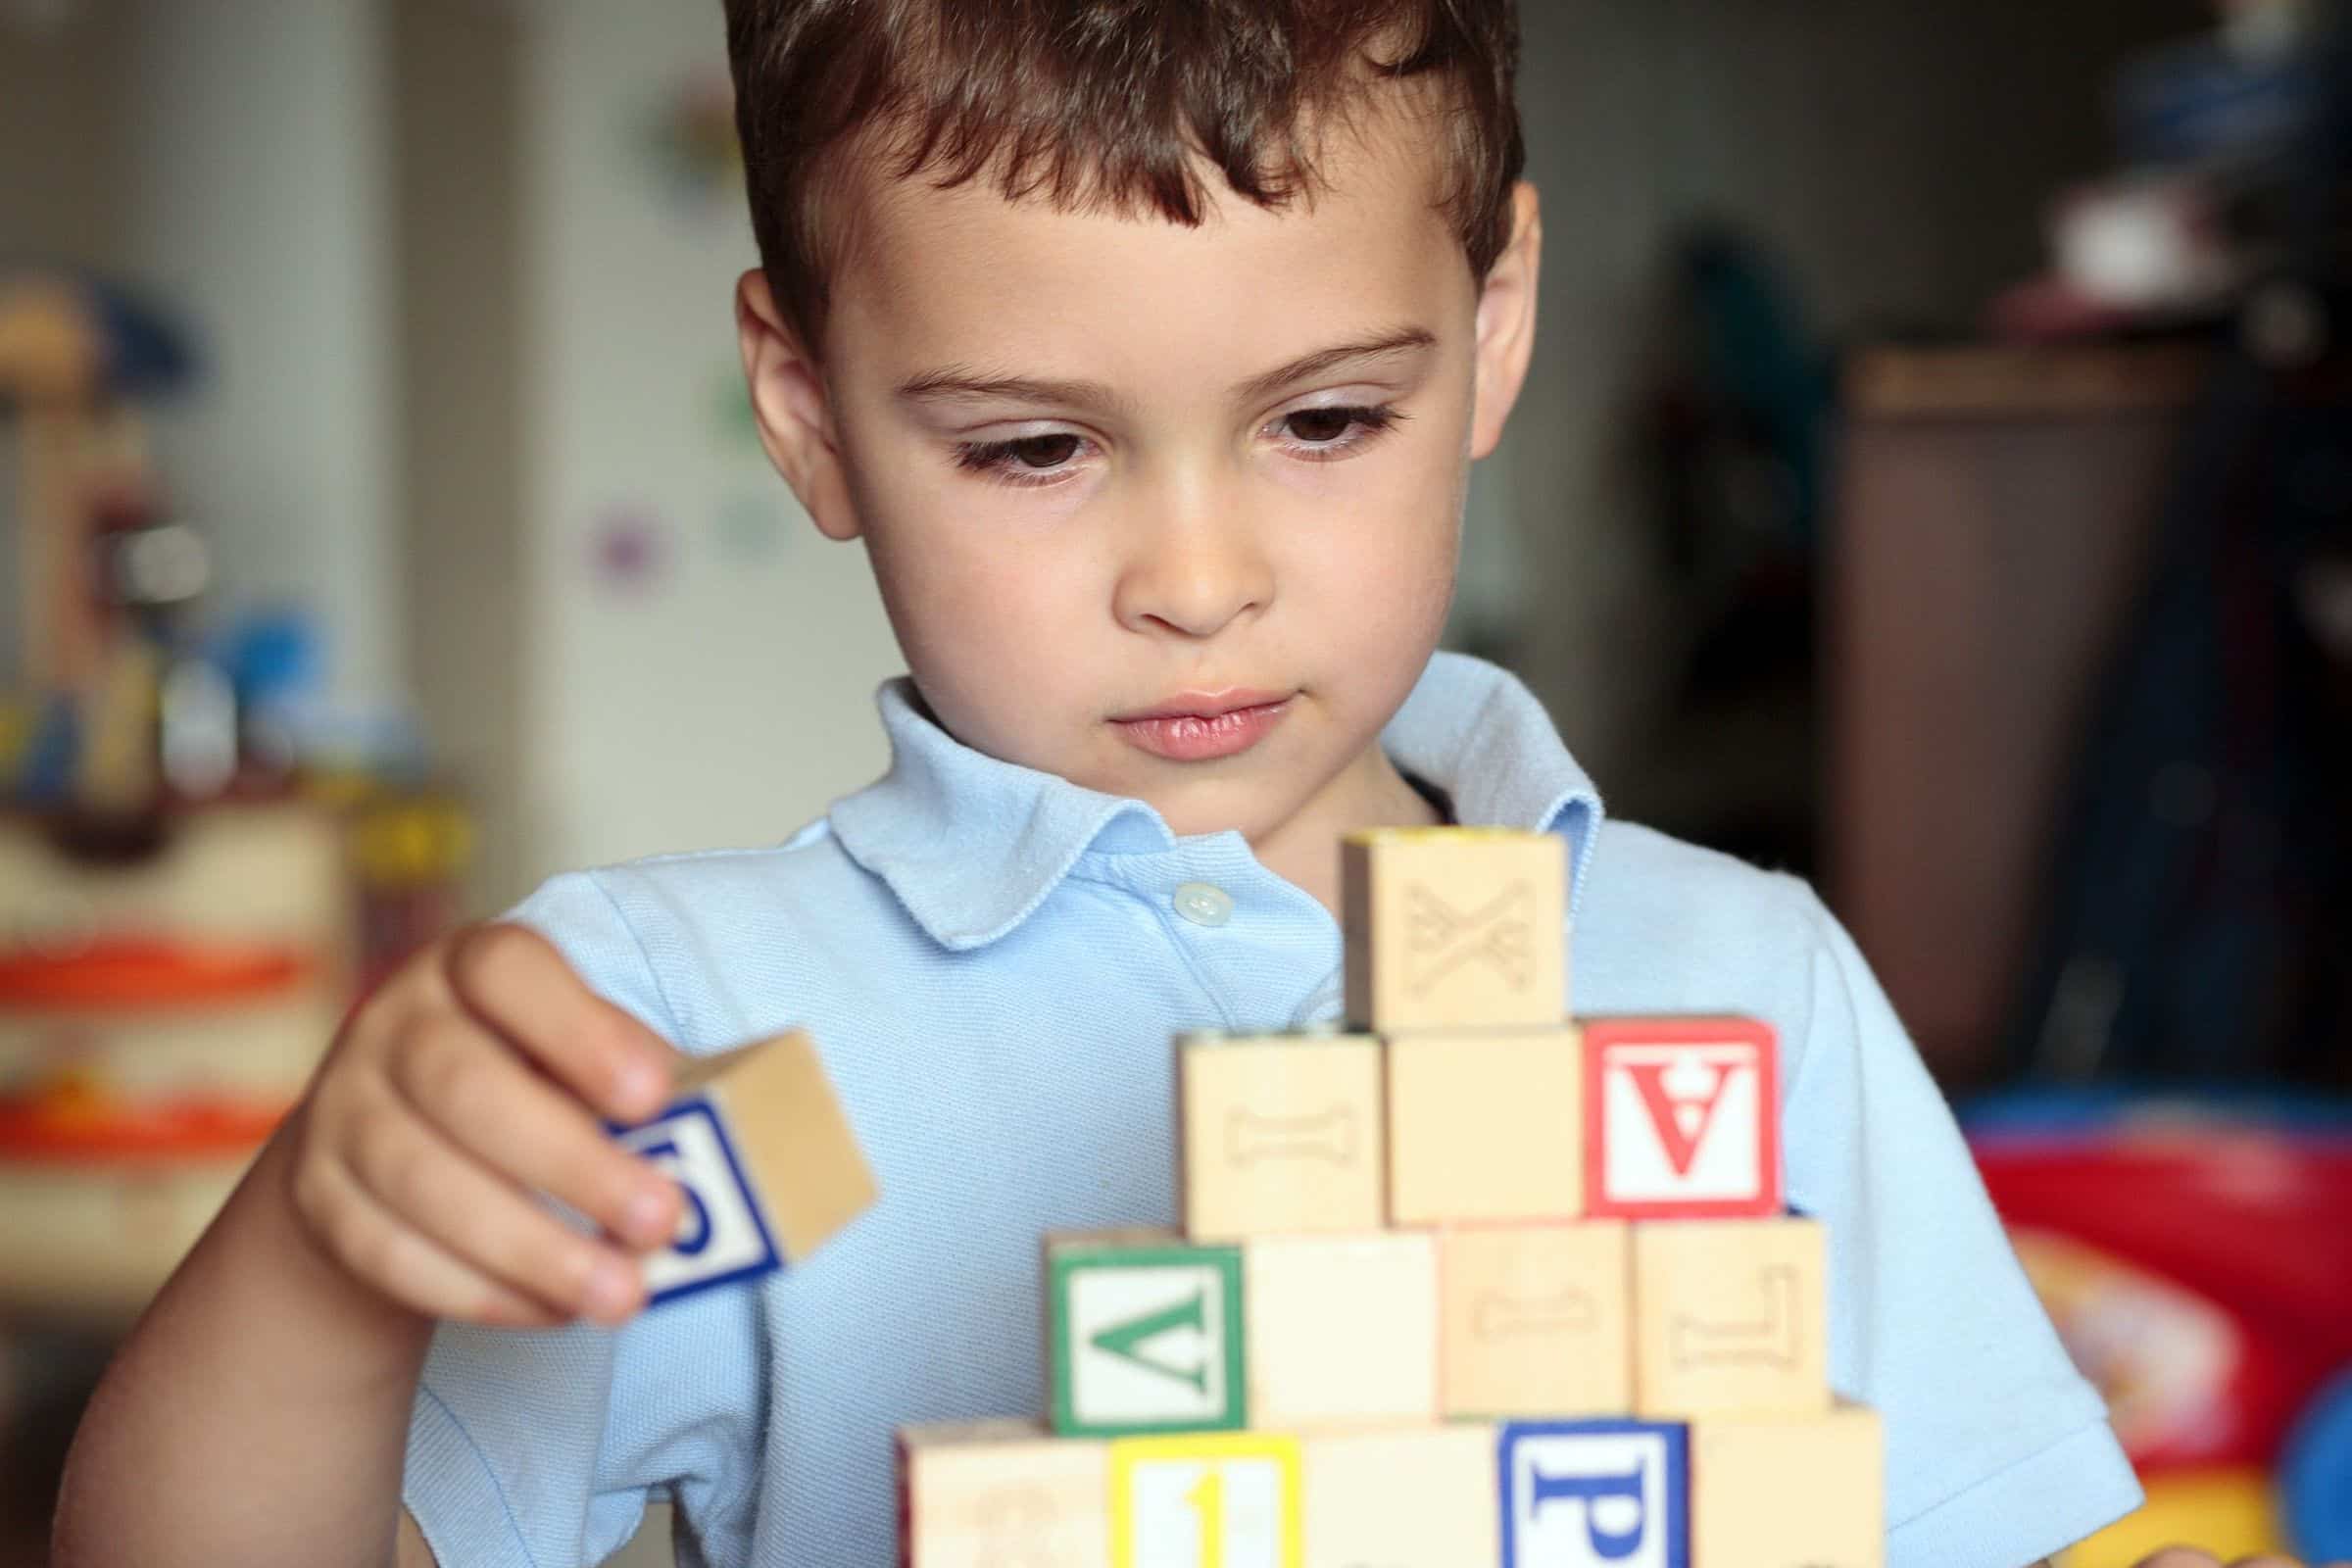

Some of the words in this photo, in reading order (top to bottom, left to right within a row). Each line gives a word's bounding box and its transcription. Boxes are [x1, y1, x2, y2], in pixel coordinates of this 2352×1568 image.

[1619, 1059, 1739, 1180] A
[1090, 1289, 1207, 1396] V
[1183, 1470, 1225, 1568] 1
[1530, 1454, 1646, 1560] P
